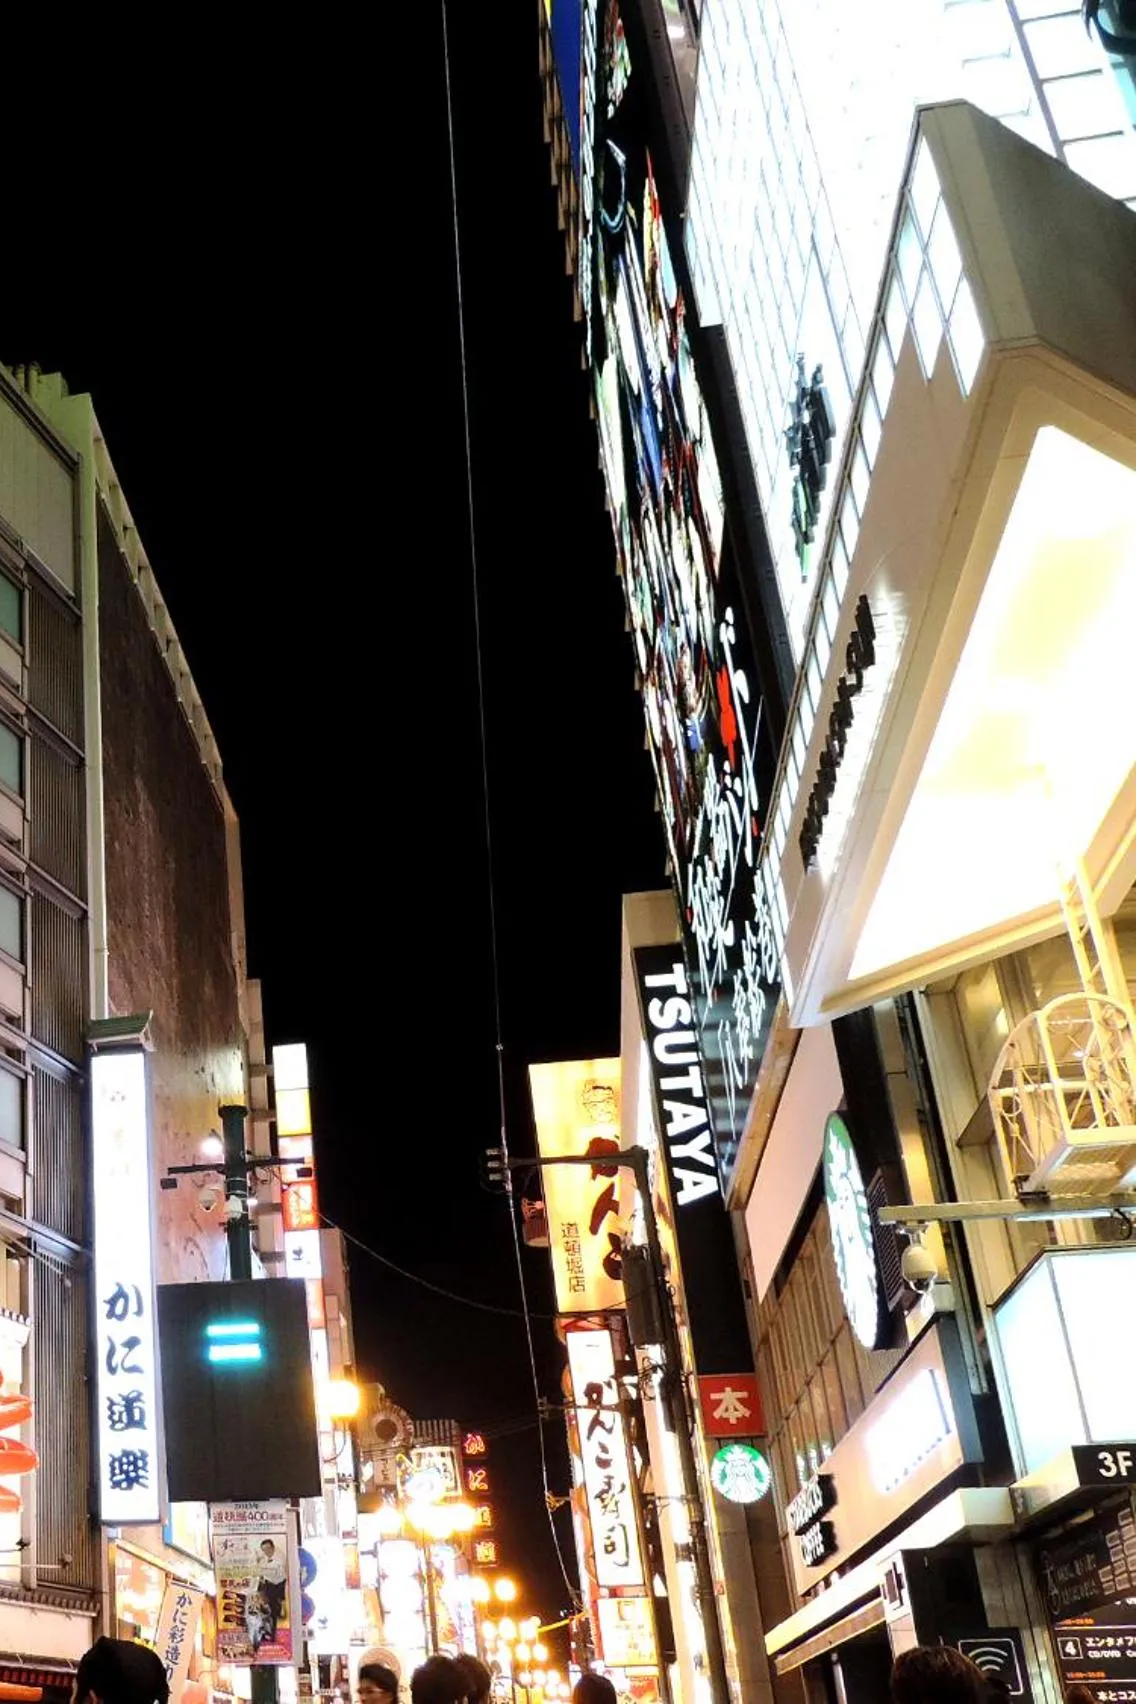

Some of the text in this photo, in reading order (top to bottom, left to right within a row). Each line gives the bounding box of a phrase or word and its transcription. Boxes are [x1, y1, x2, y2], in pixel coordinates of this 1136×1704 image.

[644, 963, 719, 1206] TSUTAYA
[710, 1387, 751, 1424] 本
[1097, 1451, 1134, 1477] 3F
[1065, 1637, 1136, 1655] 4 エンタメフ
